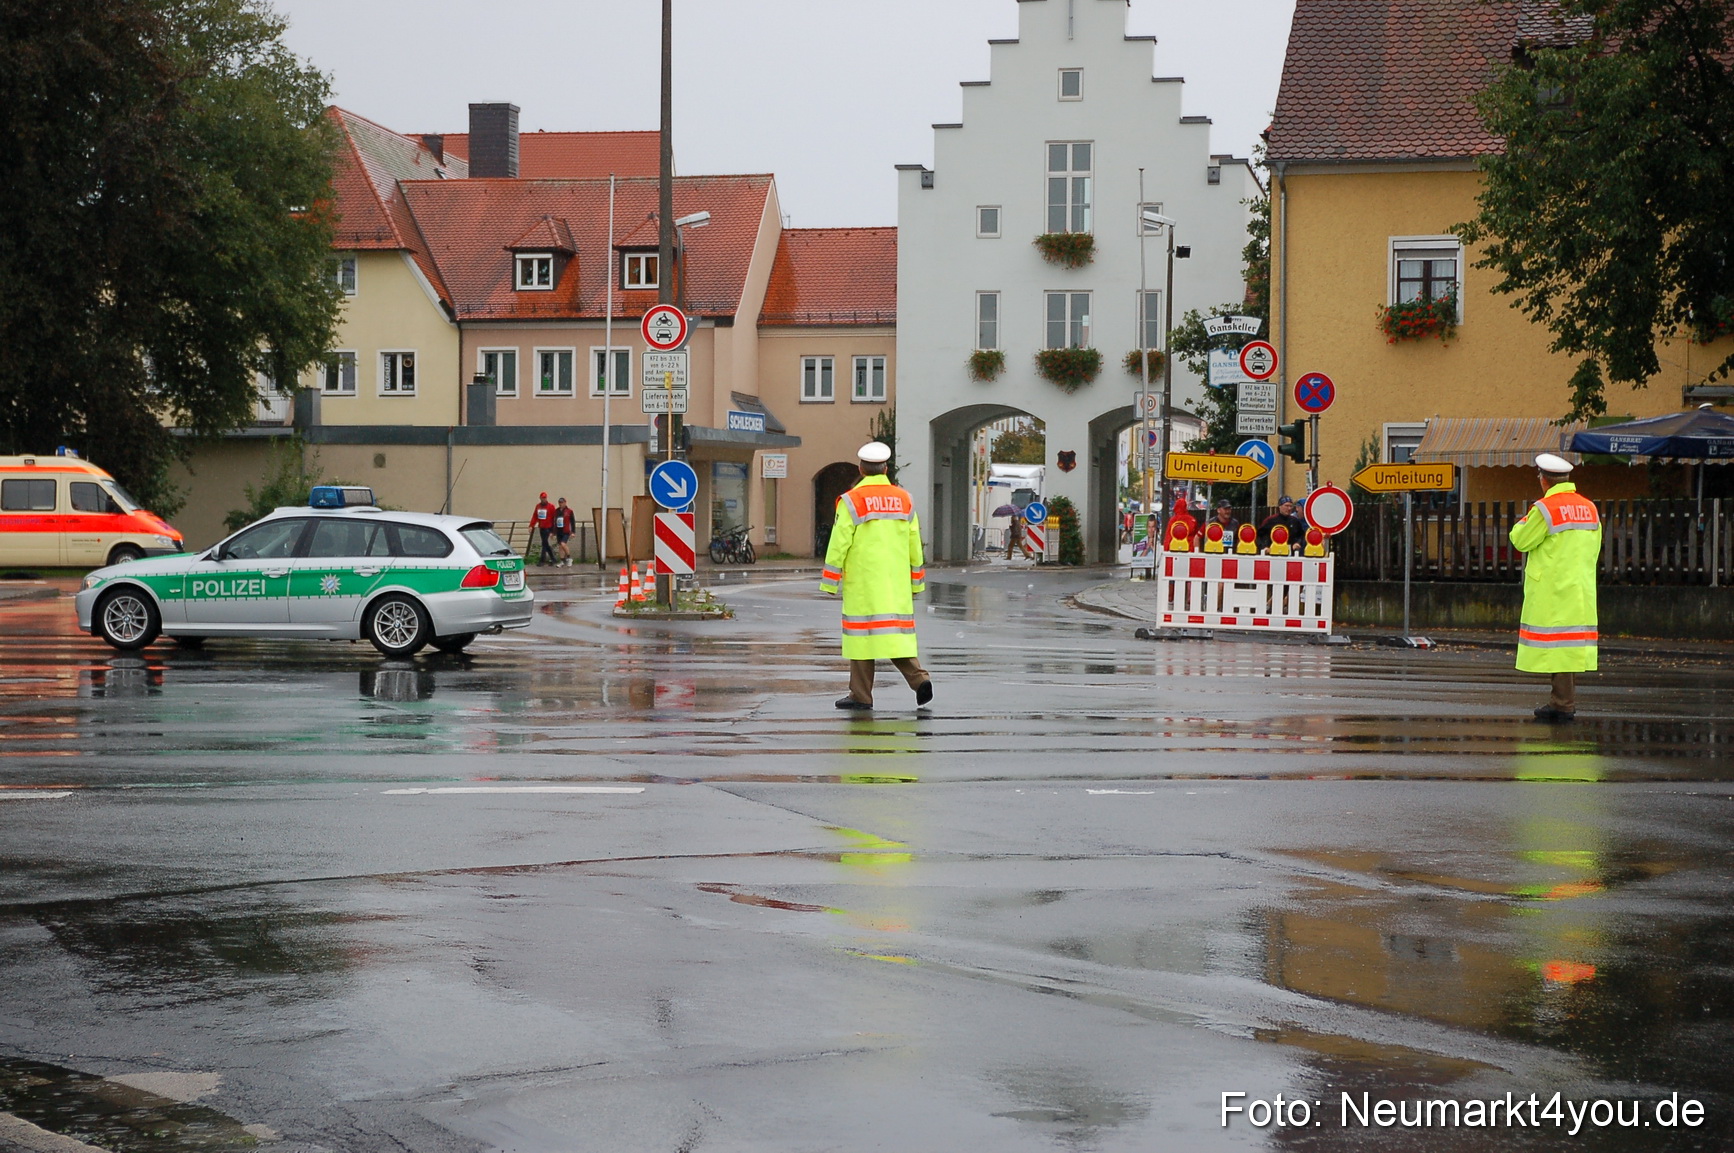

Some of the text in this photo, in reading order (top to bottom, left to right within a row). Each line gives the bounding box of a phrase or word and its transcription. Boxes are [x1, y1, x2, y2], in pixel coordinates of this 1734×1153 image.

[1209, 323, 1257, 334] Ganskeller
[730, 415, 763, 432] SCHLECKER
[1174, 460, 1243, 478] Umleitung
[1375, 472, 1443, 486] Umleitung
[865, 496, 903, 512] POLIZEI
[1560, 504, 1593, 521] POLIZEI
[496, 560, 514, 569] POLIZEI
[192, 579, 266, 596] POLIZEI
